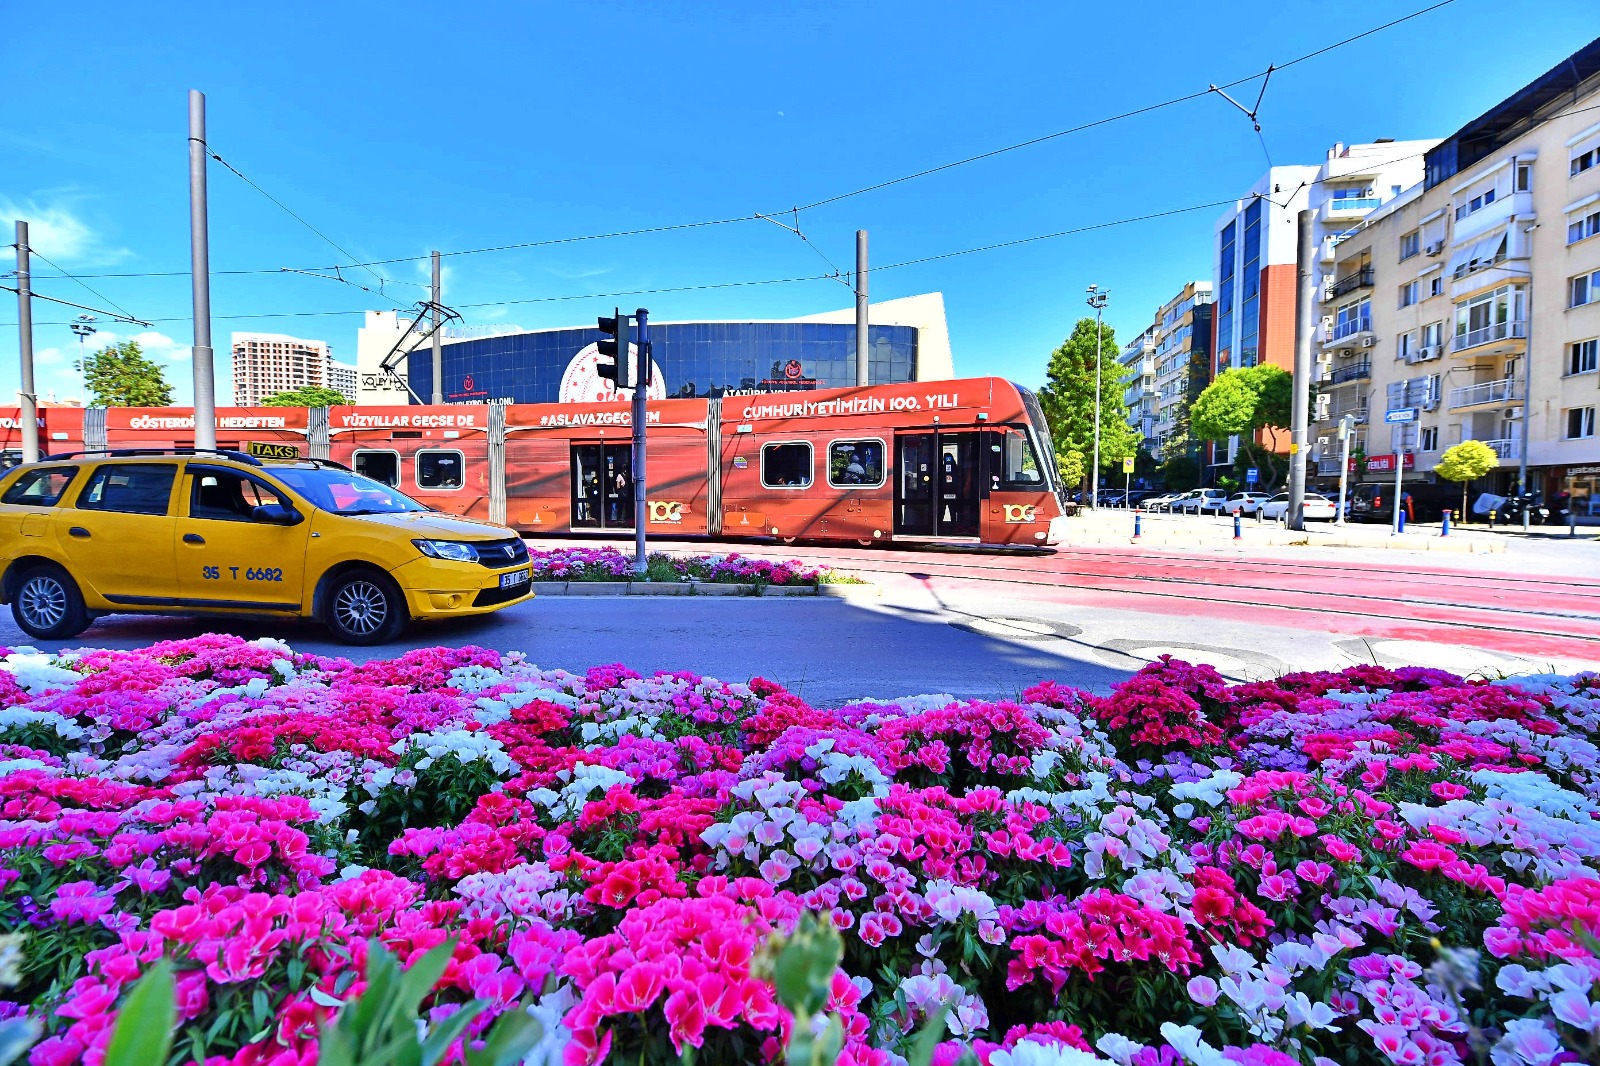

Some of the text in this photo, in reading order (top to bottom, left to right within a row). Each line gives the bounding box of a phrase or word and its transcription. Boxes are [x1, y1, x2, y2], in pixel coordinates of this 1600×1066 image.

[743, 393, 958, 419] CUMHURİYETİMİZİN 100. YILI
[130, 415, 285, 428] GÖSTERDİ HEDEFTEN
[342, 413, 474, 428] YÜZYILLAR GEÇSE DE
[540, 411, 661, 425] #ASLAVAZGEÇM
[203, 566, 282, 582] 35 T 6682
